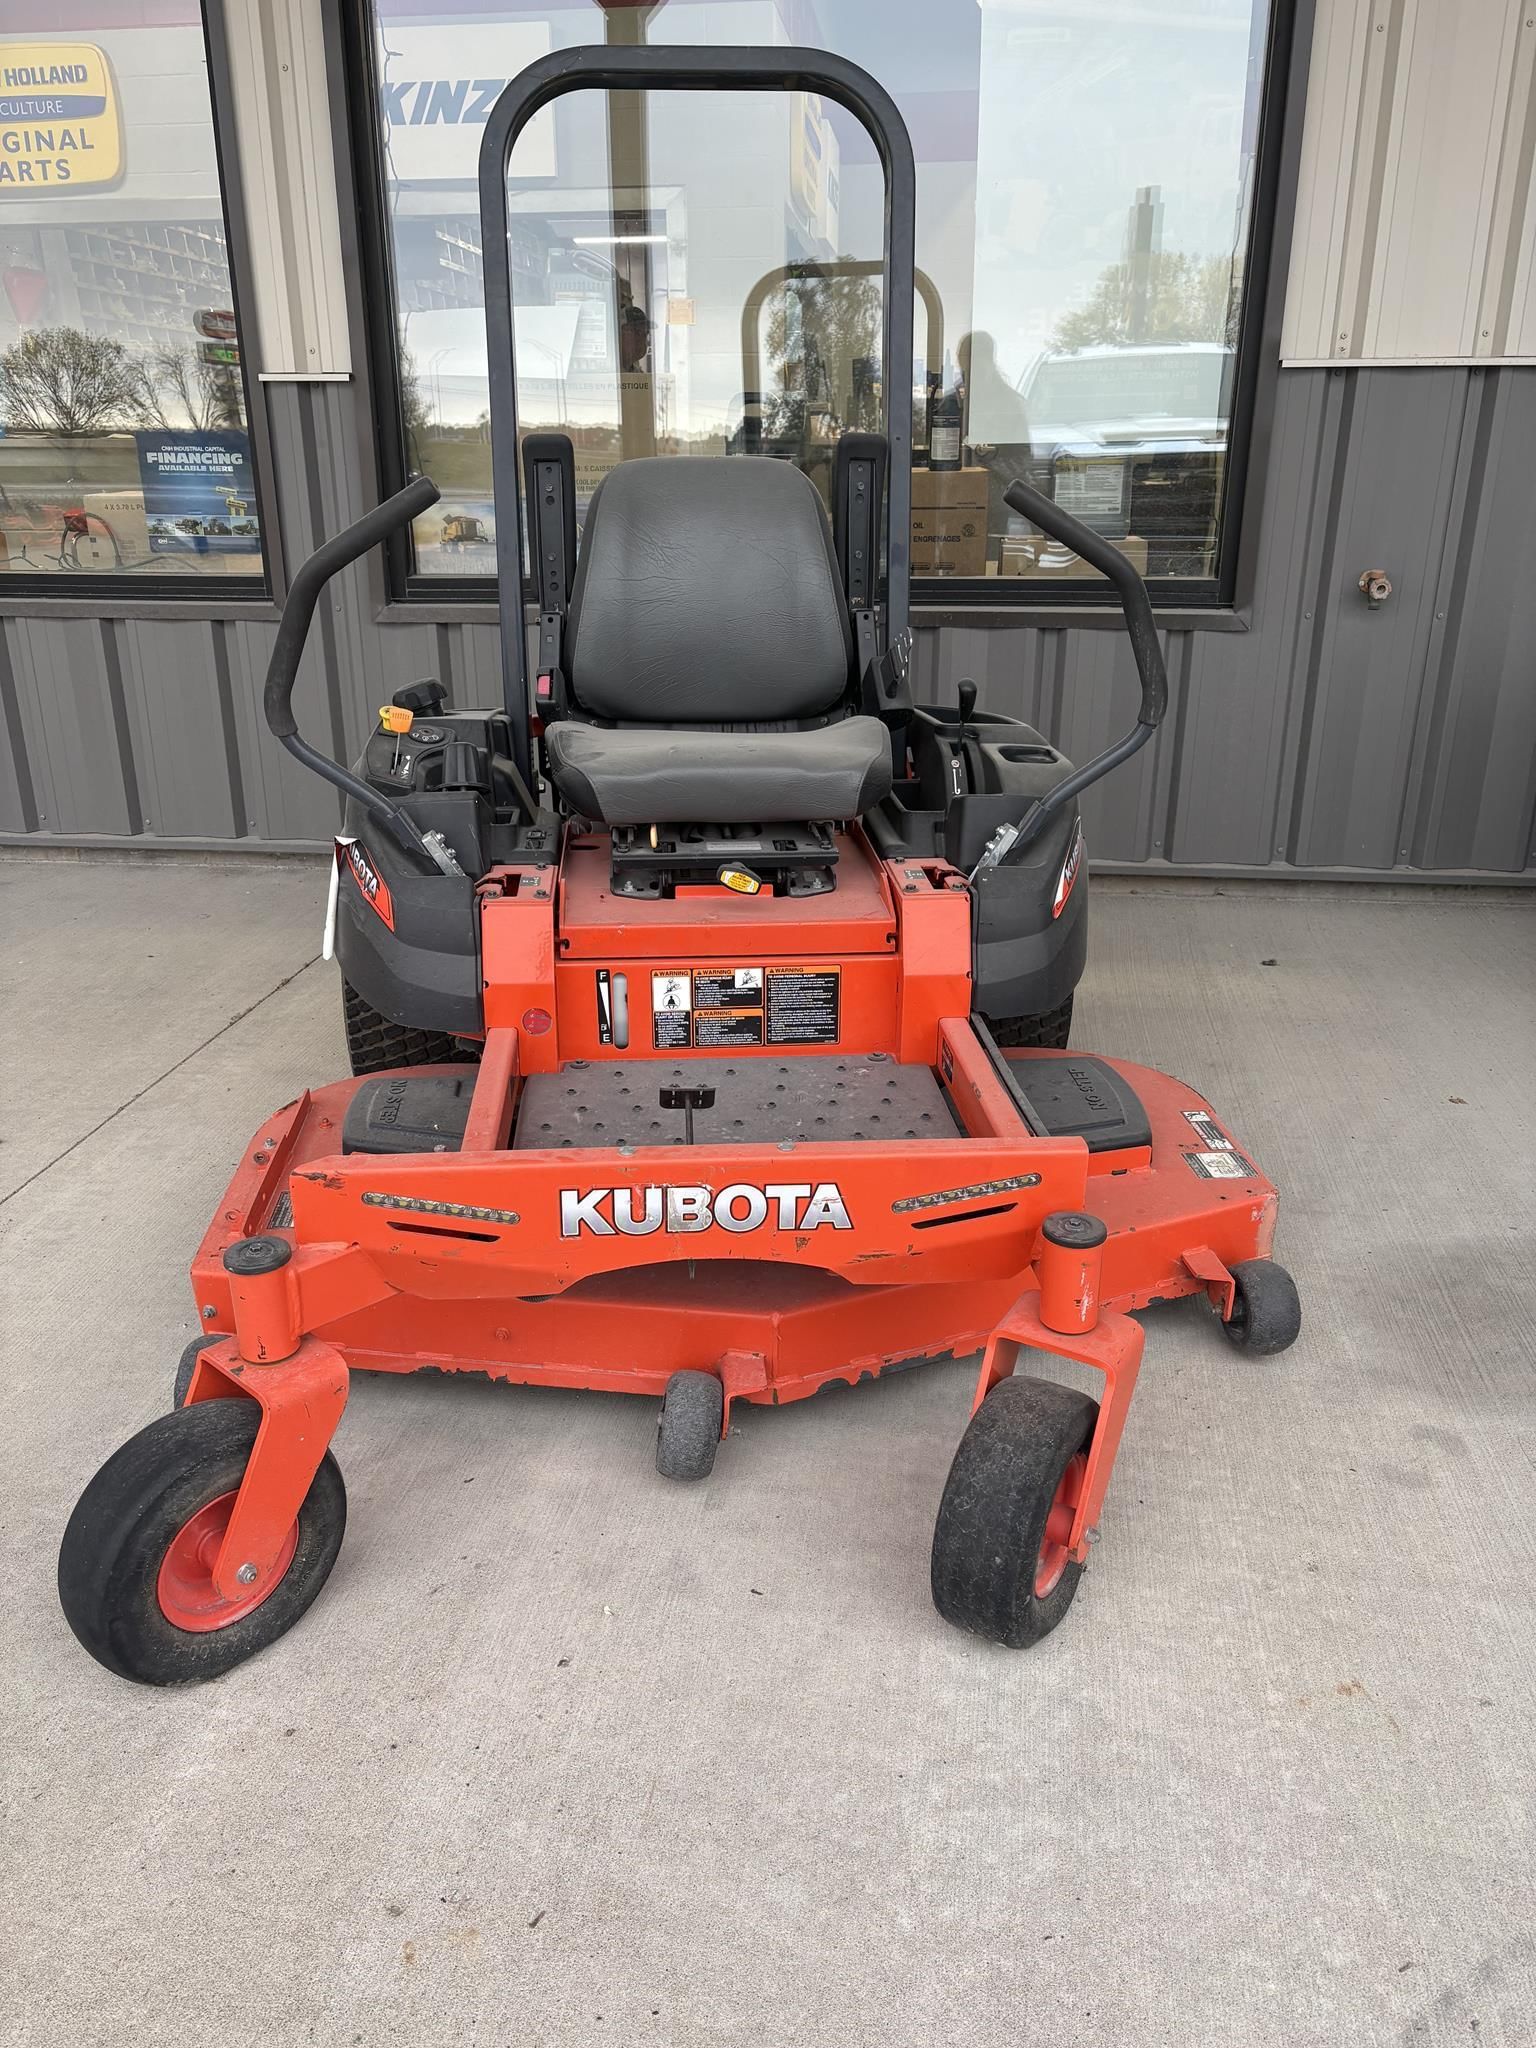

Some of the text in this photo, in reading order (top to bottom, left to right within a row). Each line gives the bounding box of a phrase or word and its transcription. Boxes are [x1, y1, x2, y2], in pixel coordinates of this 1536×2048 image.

[4, 64, 88, 87] HOLLAND
[381, 78, 511, 126] KINZ
[146, 452, 243, 464] FINANCING
[599, 971, 607, 981] F
[603, 1033, 610, 1042] E
[380, 1096, 403, 1124] STEP
[559, 1183, 855, 1237] KUBOTA
